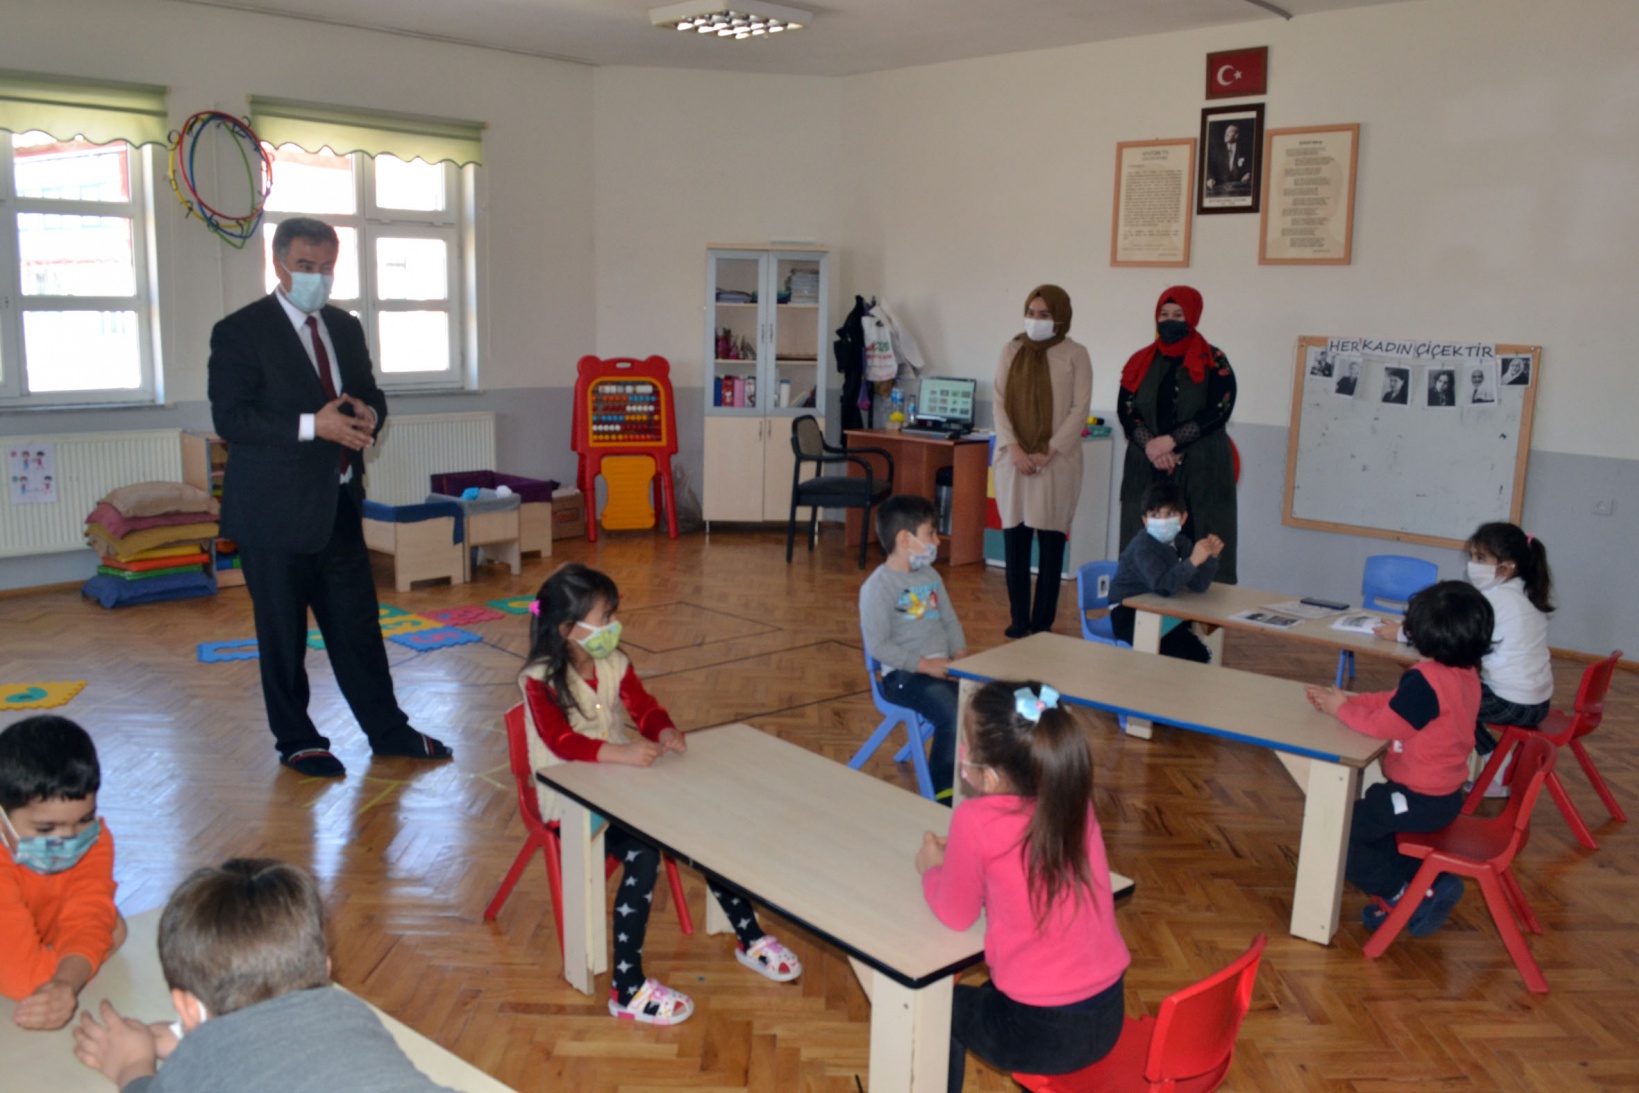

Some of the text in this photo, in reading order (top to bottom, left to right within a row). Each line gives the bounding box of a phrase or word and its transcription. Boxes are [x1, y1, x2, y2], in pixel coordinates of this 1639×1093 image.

[1329, 339, 1494, 359] HER KADIN ÇİÇEKTİR
